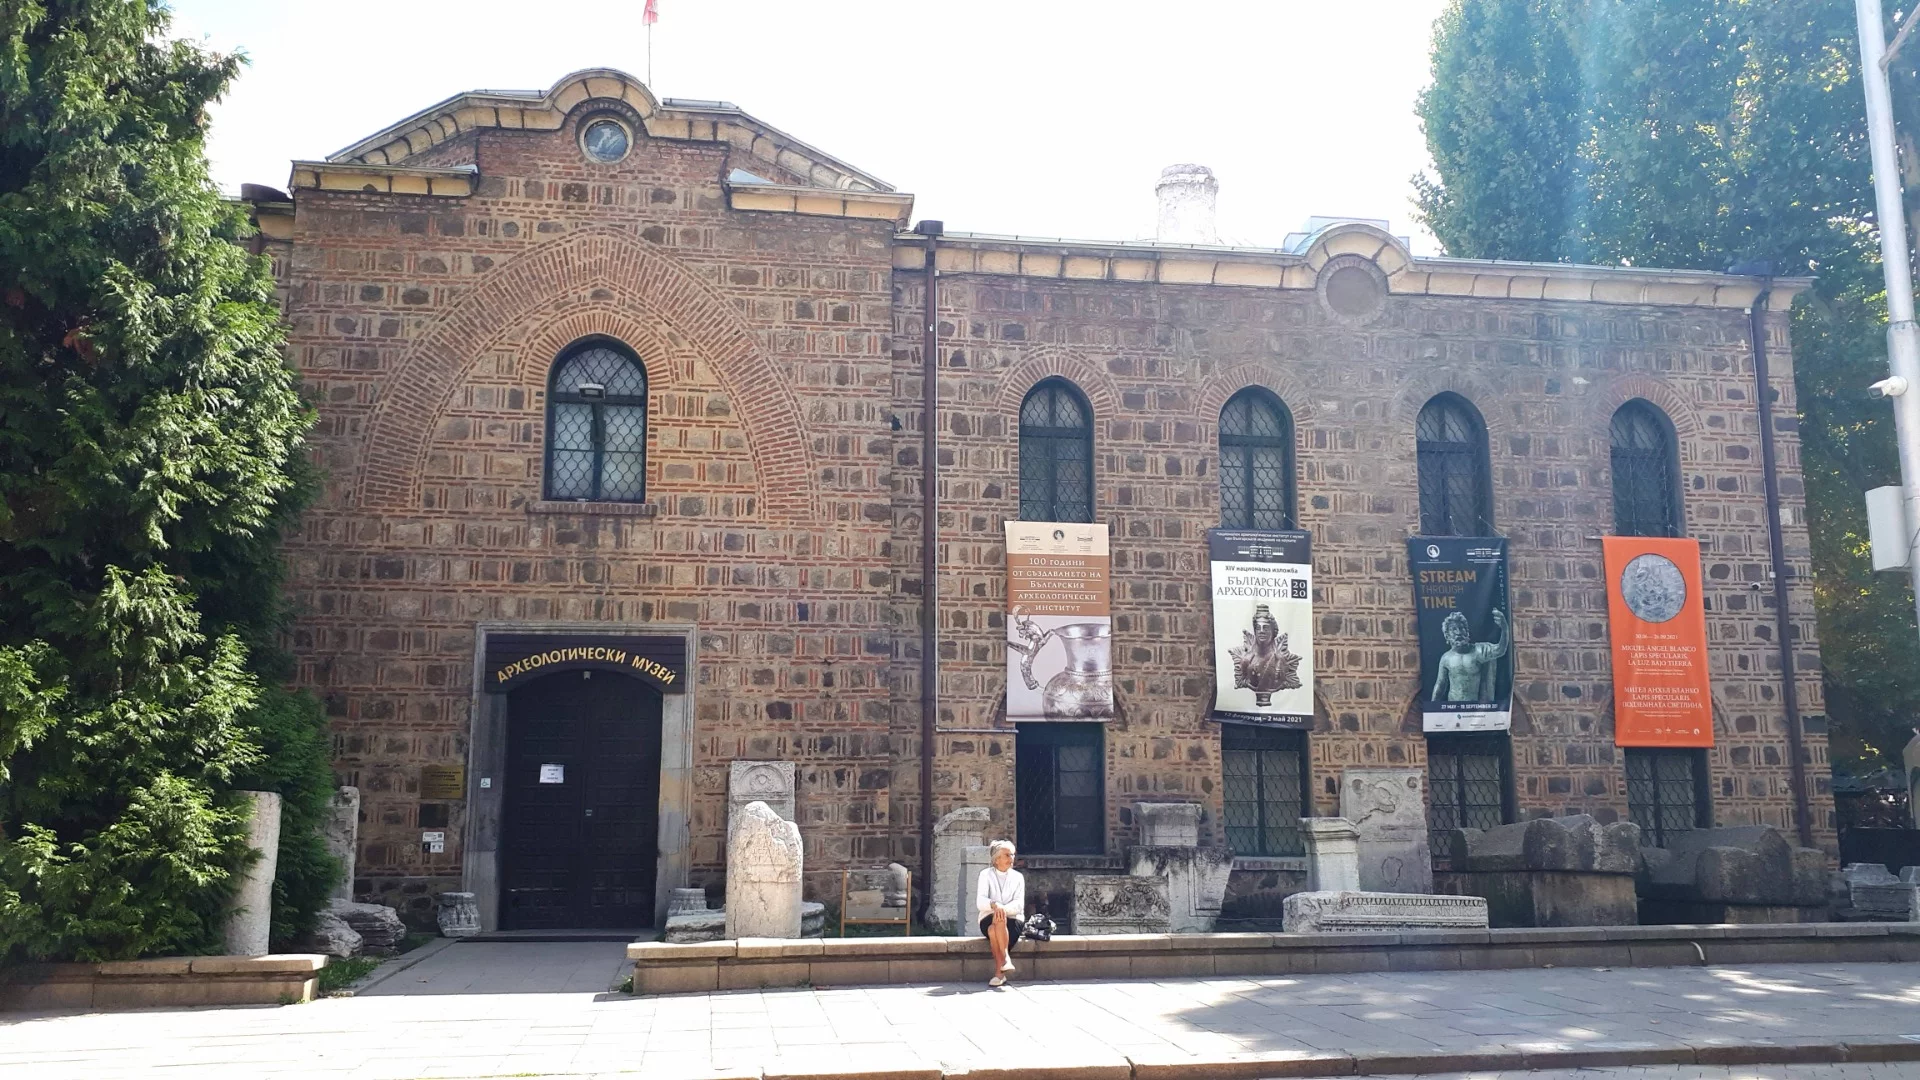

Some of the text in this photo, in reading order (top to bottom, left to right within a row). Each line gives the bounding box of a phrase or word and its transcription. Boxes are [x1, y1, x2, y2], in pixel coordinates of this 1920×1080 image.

[1228, 576, 1288, 587] БЪЛГАРСКА
[1420, 571, 1476, 582] STREAM
[1216, 587, 1288, 598] АРХЕОЛОГИЯ
[1422, 585, 1464, 594] THROUGH
[1422, 596, 1456, 608] TIME
[497, 647, 676, 685] АРХЕОЛОГИЧЕСКИ МУЗЕЙ
